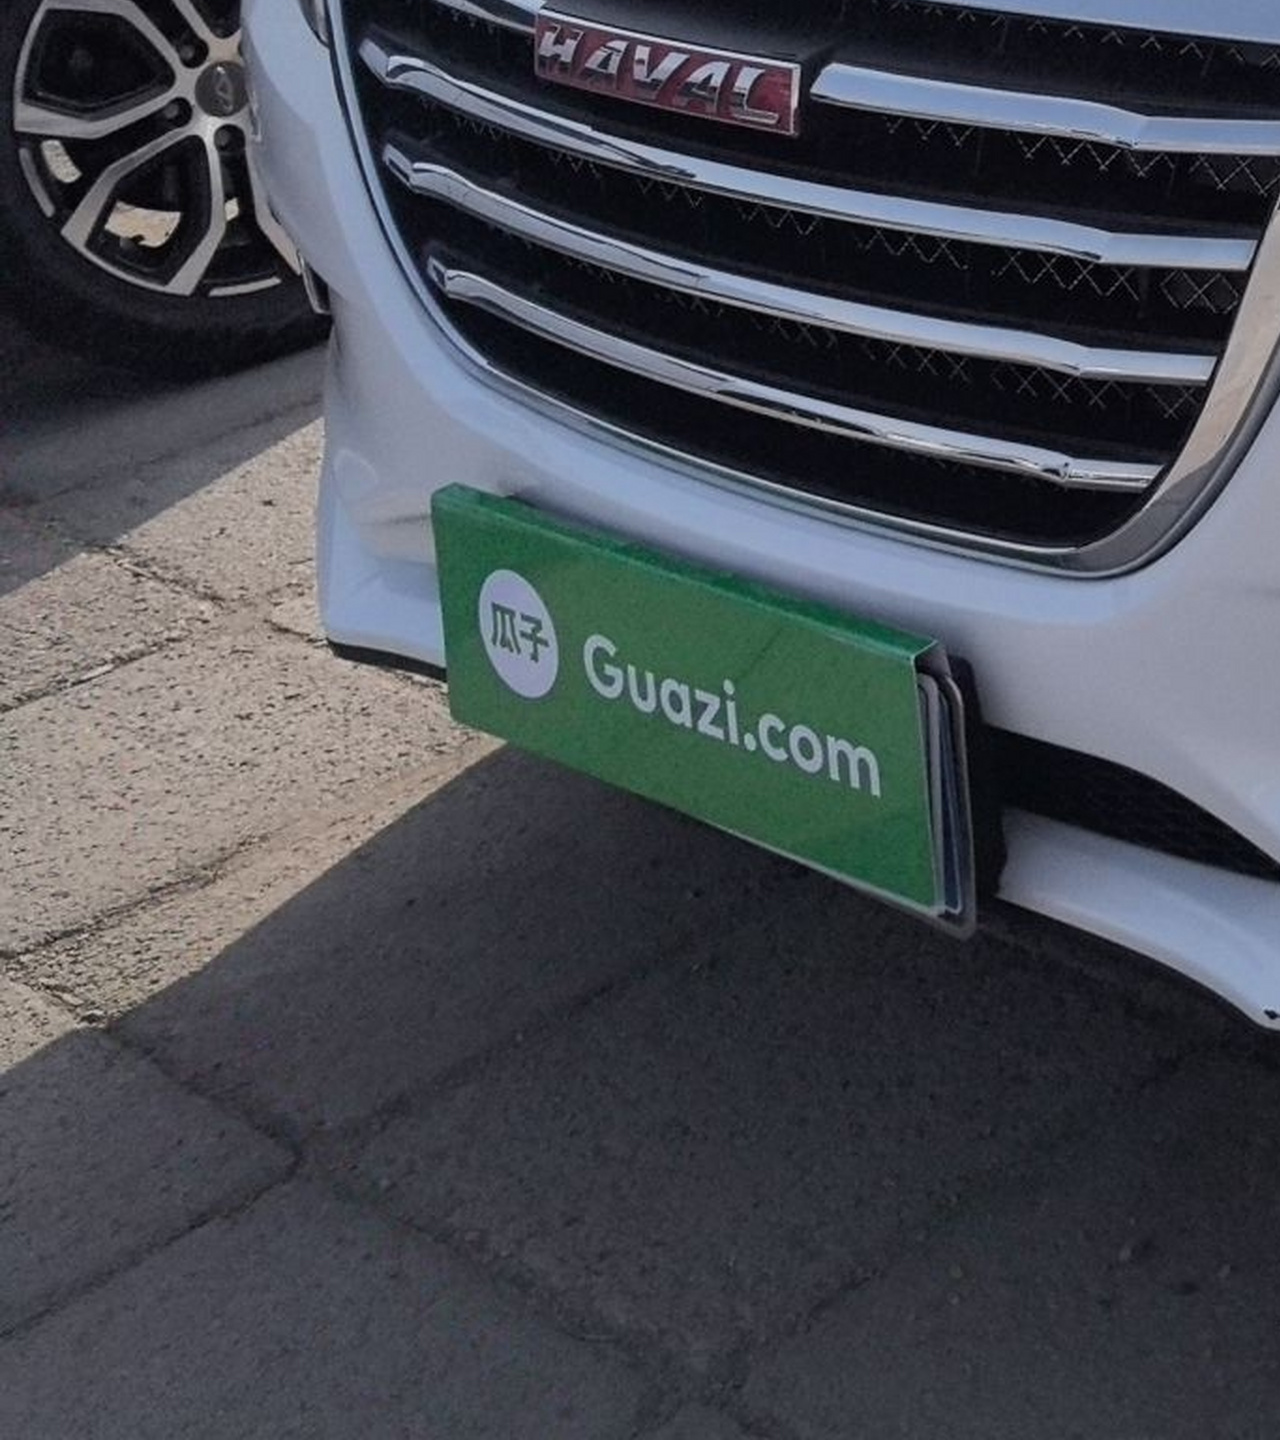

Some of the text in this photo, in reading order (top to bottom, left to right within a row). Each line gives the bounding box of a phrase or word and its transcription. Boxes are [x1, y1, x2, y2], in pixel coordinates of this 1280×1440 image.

[537, 23, 780, 125] HAVAL
[491, 601, 550, 664] 瓜子
[583, 634, 881, 799] Guazi.com
